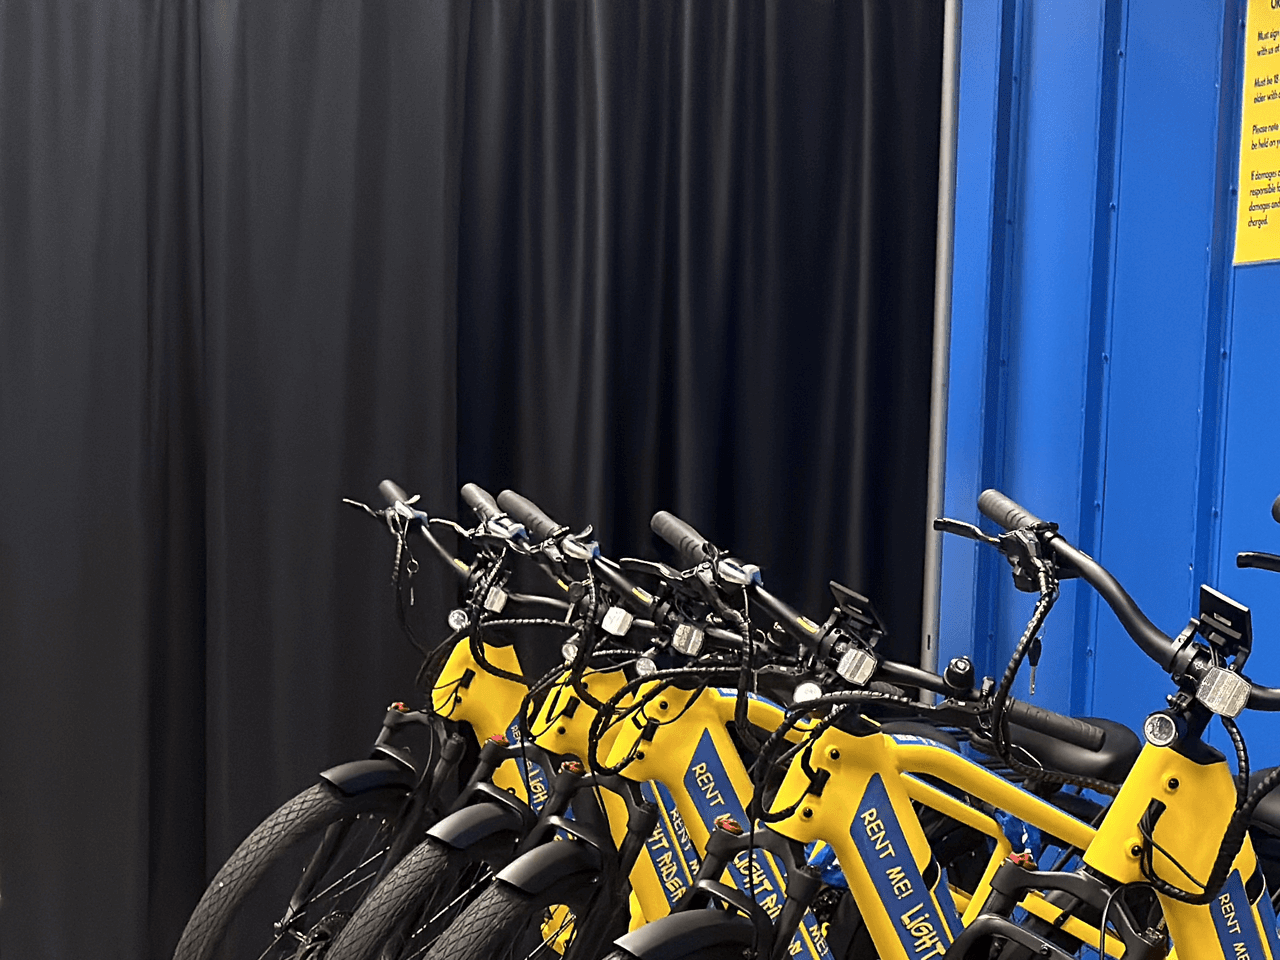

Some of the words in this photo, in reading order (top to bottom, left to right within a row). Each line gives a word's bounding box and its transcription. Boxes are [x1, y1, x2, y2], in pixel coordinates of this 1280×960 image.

[1258, 31, 1269, 41] Must
[1270, 29, 1279, 40] sign
[1257, 47, 1267, 56] with
[1254, 78, 1266, 87] Must
[1254, 93, 1266, 103] older
[1267, 90, 1277, 100] with
[1252, 125, 1267, 134] Please
[1268, 123, 1279, 131] note
[1258, 138, 1268, 148] held
[1255, 171, 1276, 181] damages
[1250, 184, 1276, 198] responsible
[1249, 201, 1270, 212] damages
[1271, 198, 1280, 208] and
[1248, 215, 1268, 229] charged.
[528, 769, 548, 811] LIGH
[692, 762, 725, 807] RENT
[861, 807, 896, 859] RENT
[886, 865, 914, 900] ME!
[656, 850, 687, 903] RIDER
[1218, 892, 1241, 935] RENT
